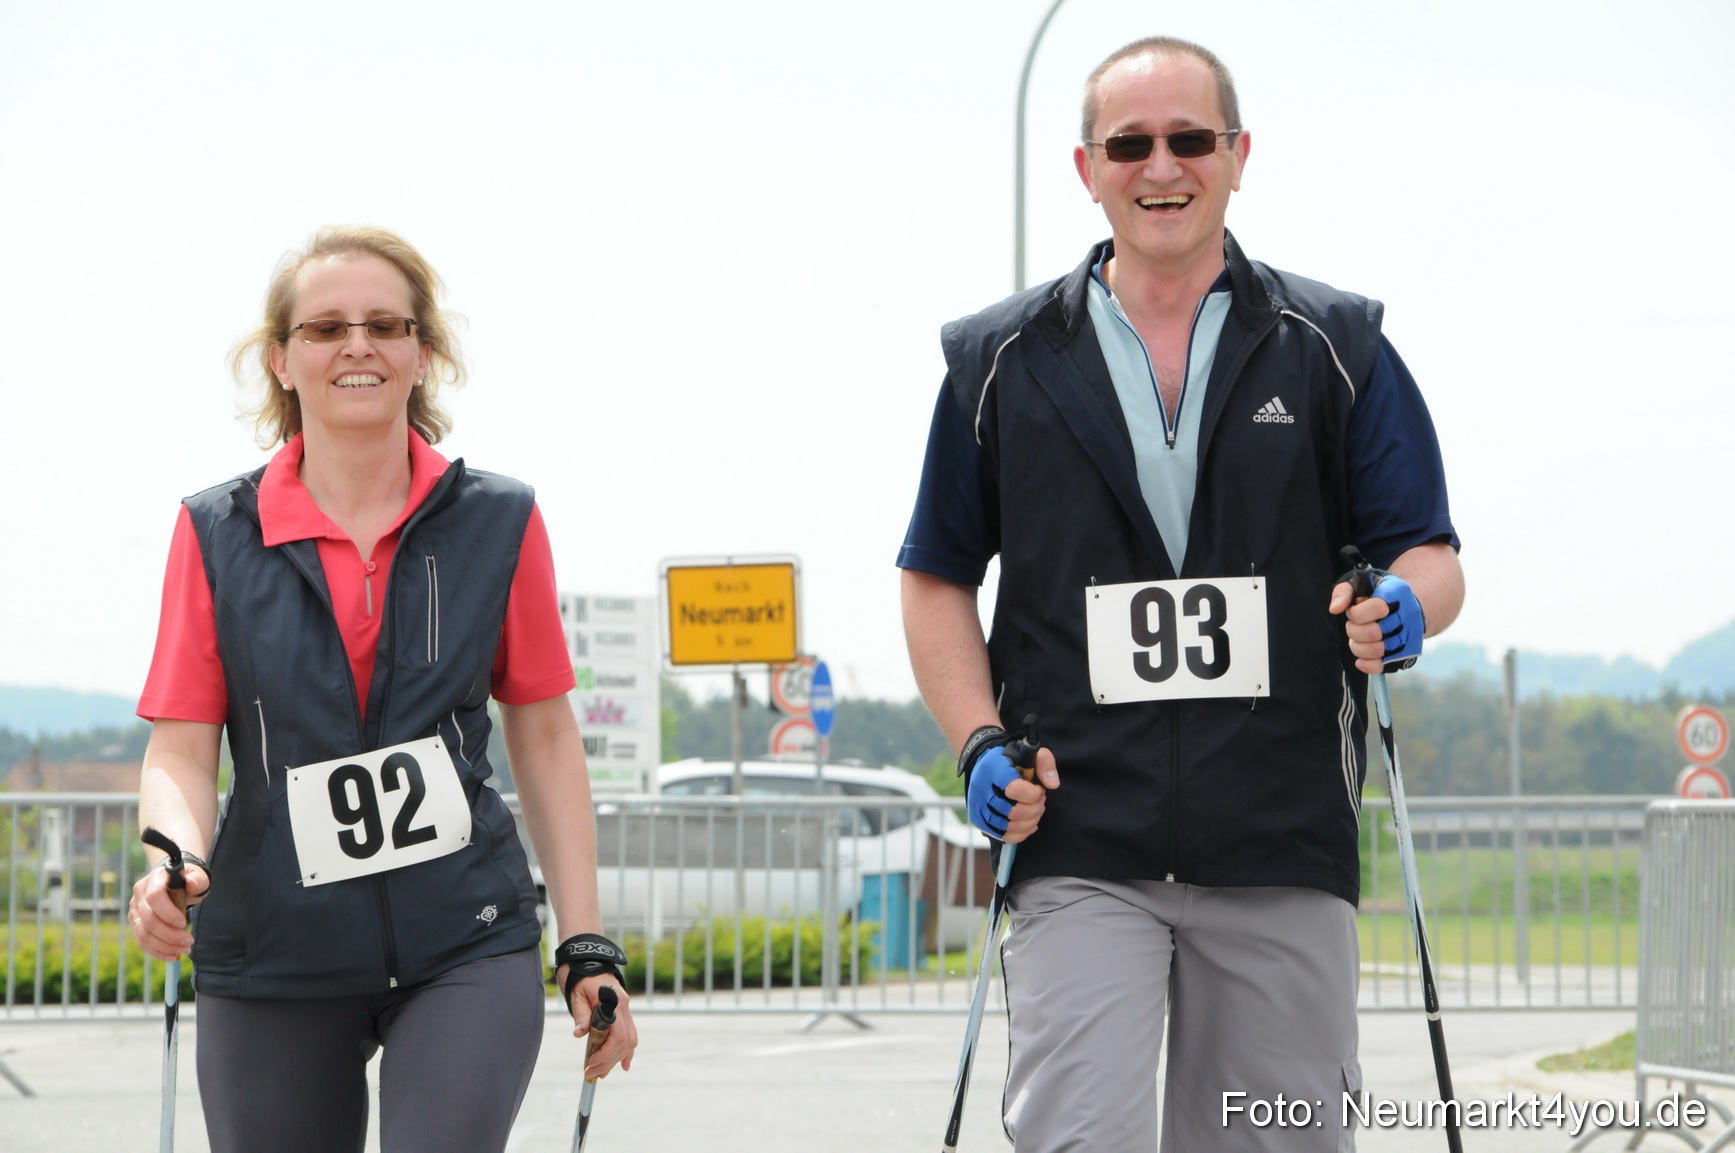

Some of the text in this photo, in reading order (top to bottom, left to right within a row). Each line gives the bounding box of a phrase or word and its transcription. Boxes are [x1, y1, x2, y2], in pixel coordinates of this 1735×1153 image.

[1252, 413, 1295, 424] adidas
[680, 600, 785, 625] Neumarkt
[1130, 583, 1231, 683] 93
[1691, 721, 1719, 750] 60
[328, 752, 438, 860] 92
